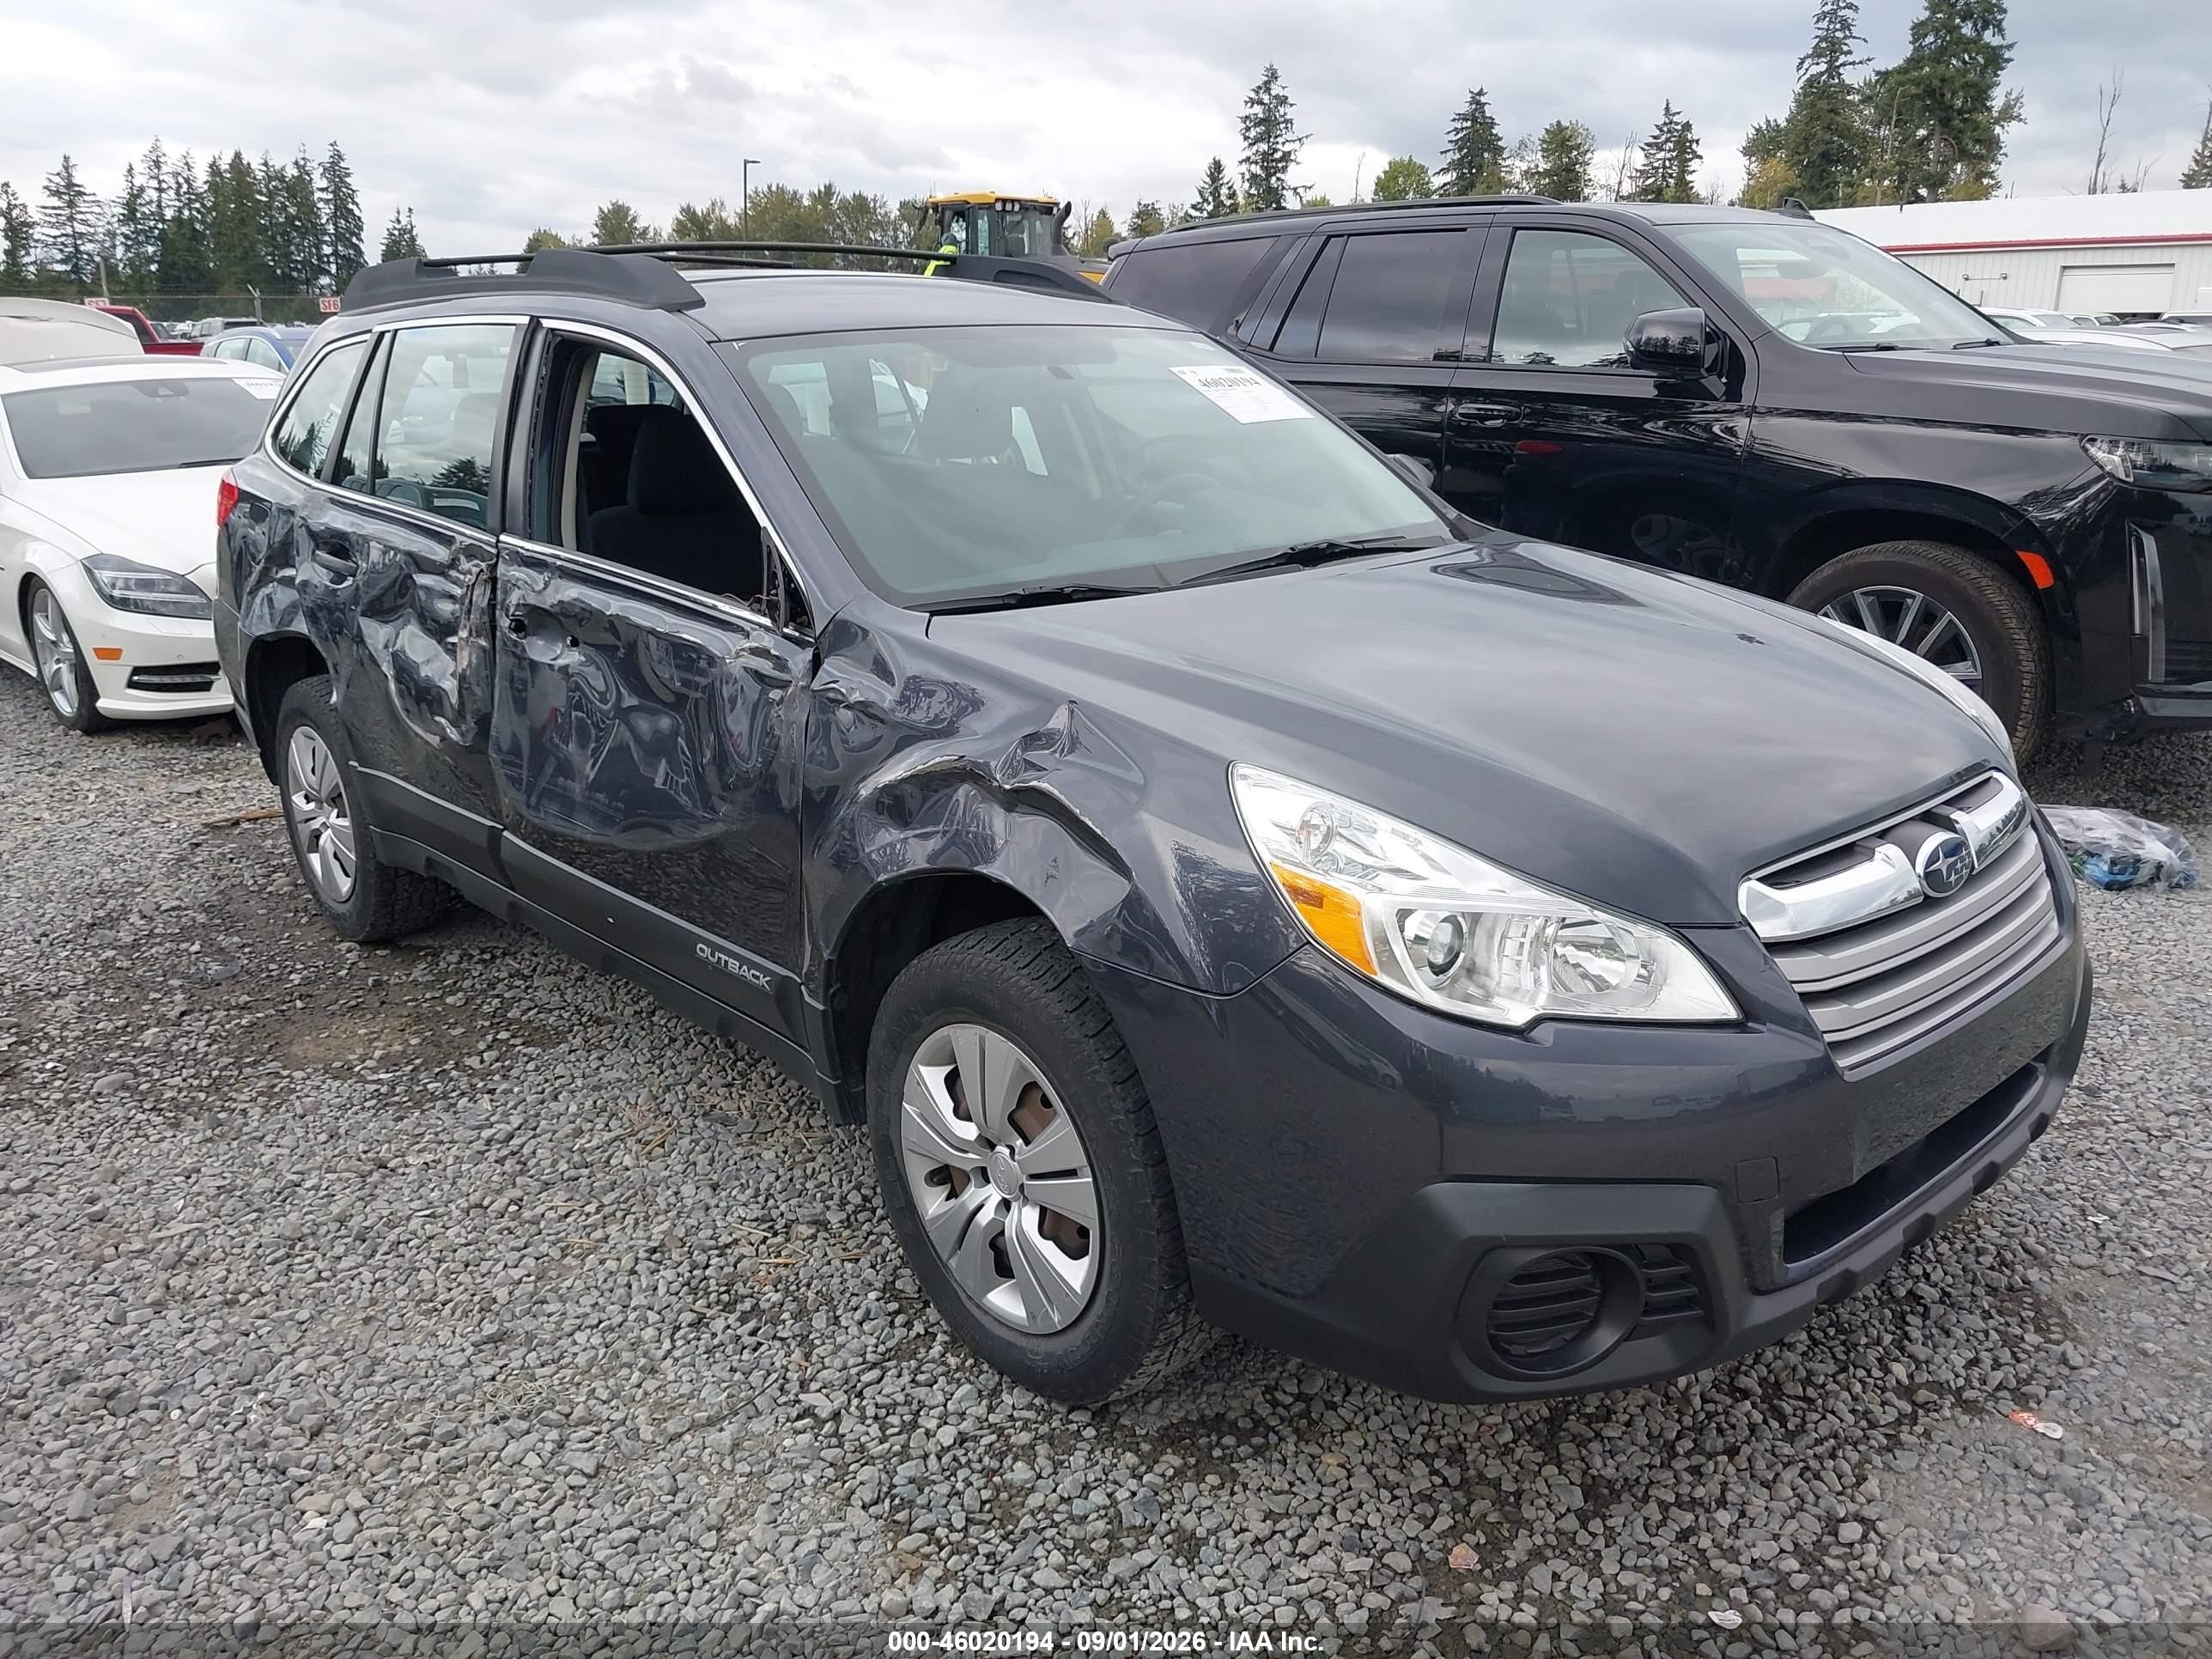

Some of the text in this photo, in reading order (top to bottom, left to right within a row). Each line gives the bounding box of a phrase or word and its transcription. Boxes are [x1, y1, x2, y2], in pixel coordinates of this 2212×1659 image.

[321, 299, 339, 311] SF6
[1197, 376, 1262, 389] 46020194
[696, 943, 772, 991] OUTBACK
